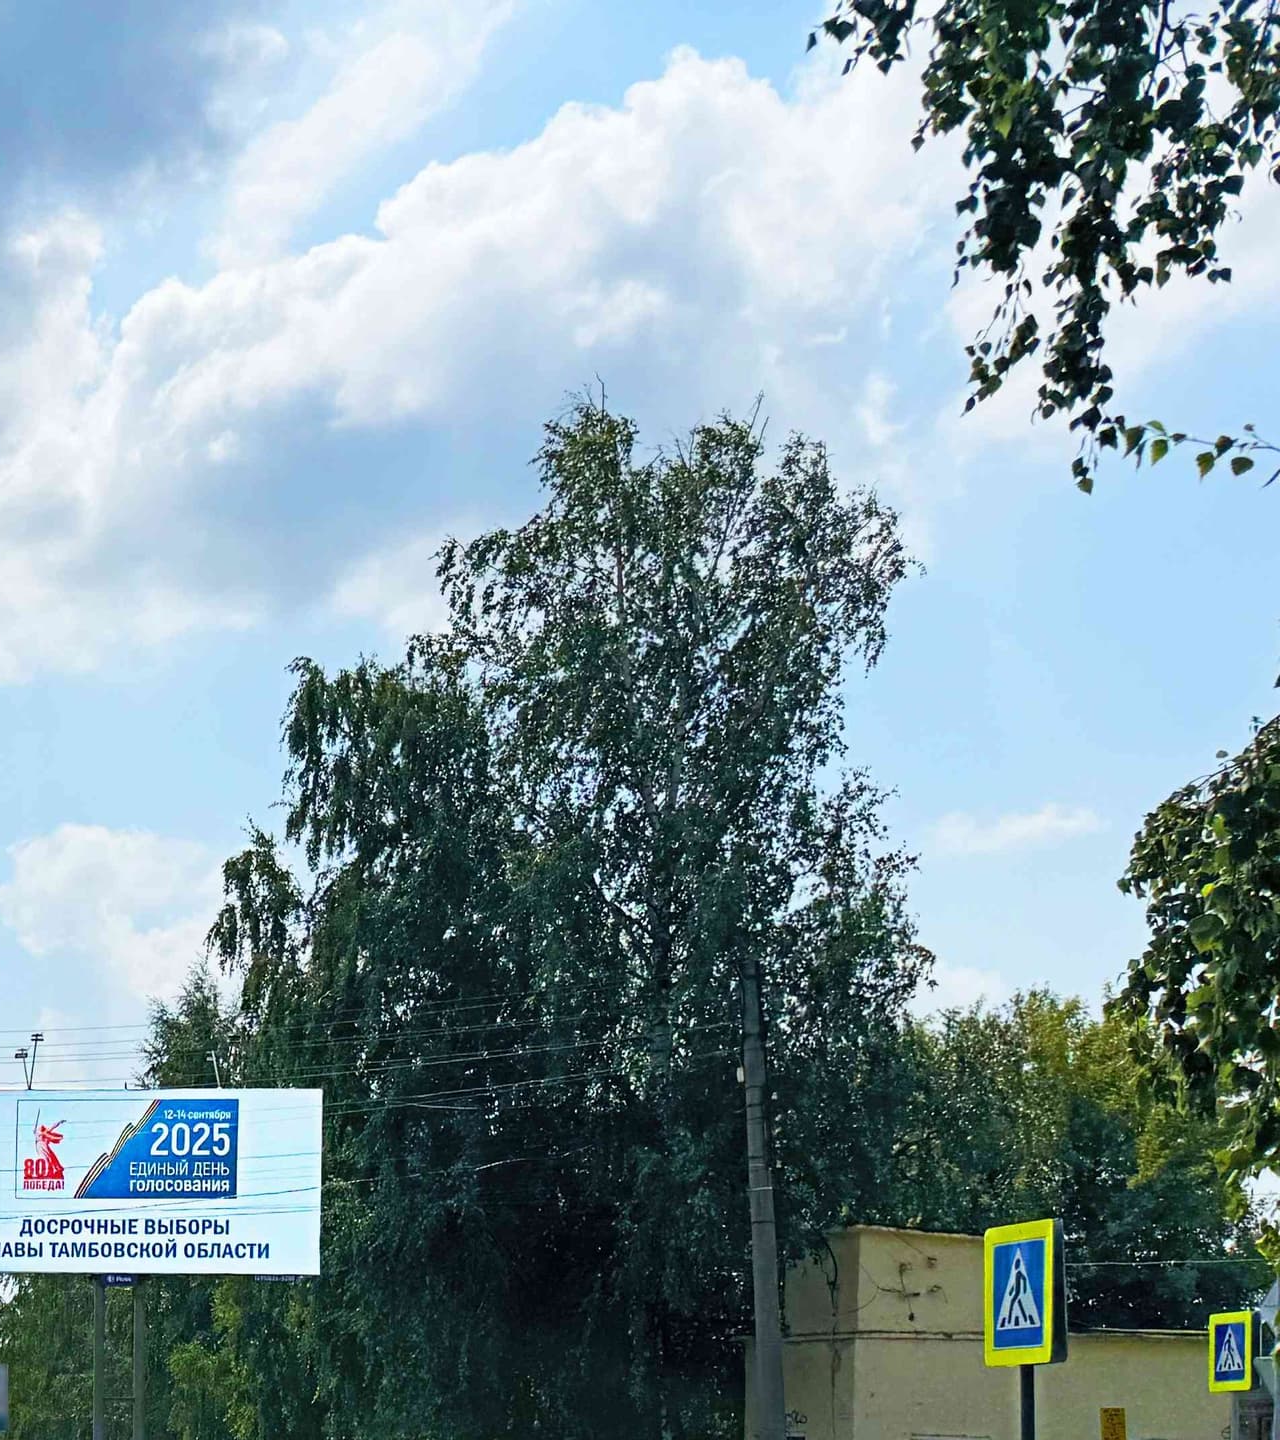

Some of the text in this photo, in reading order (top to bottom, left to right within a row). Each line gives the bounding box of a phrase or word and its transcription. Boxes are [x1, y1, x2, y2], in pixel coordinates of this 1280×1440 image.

[187, 1109, 231, 1120] сентября
[150, 1122, 230, 1156] 2025
[129, 1160, 230, 1177] ЕДИНЫЙ ДЕНЬ
[23, 1180, 65, 1191] ПОБЕДА!
[19, 1218, 230, 1237] ДОСРОЧНЫЕ ВЫБОРЫ
[49, 1239, 177, 1259] ТАМБОВСКОЙ
[183, 1243, 270, 1259] ОБЛАСТИ
